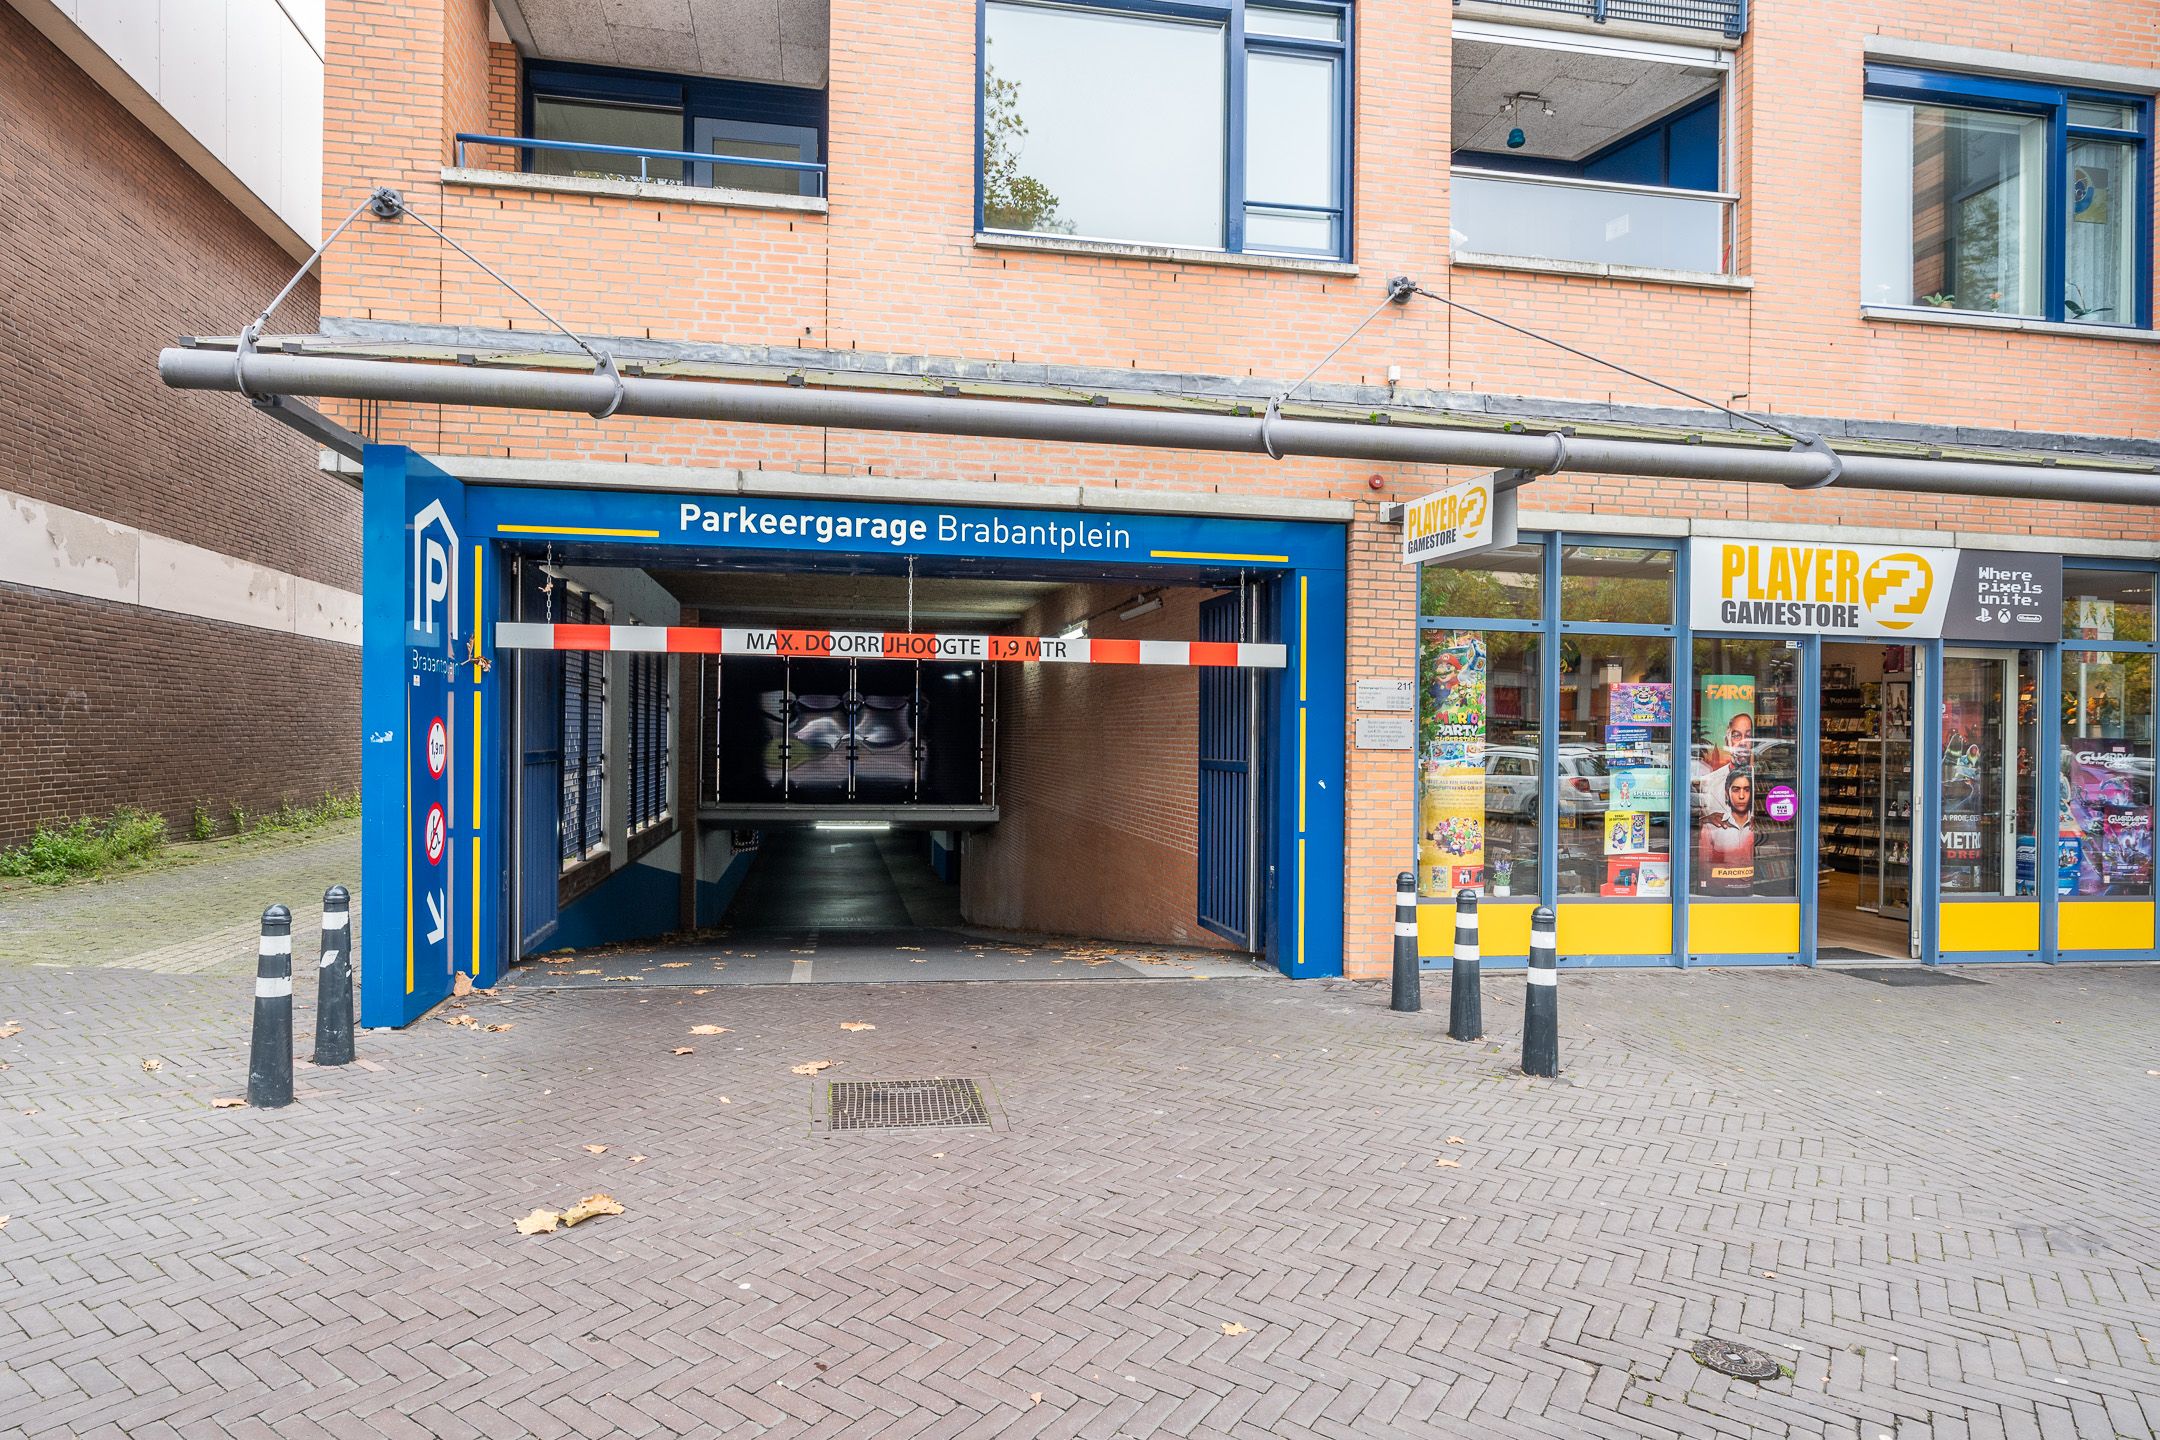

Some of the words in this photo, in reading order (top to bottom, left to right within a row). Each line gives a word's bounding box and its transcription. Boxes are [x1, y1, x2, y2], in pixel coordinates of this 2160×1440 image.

[1408, 495, 1457, 541] PLAYER
[680, 503, 927, 547] Parkeergarage
[938, 514, 1130, 554] Brabantplein
[1408, 529, 1457, 555] GAMESTORE
[1721, 544, 1860, 604] PLAYER
[1978, 566, 2033, 581] Where
[1978, 581, 2043, 595] pixels
[1978, 592, 2039, 607] unite.
[1721, 600, 1859, 629] GAMESTORE
[746, 632, 799, 651] MAX.
[805, 634, 981, 656] DOORRIJHOOGTE
[992, 640, 1020, 658] 1,9
[1025, 641, 1067, 658] MTR
[1397, 682, 1411, 691] 211
[1435, 711, 1479, 724] MARIO
[1436, 724, 1478, 737] PARTY
